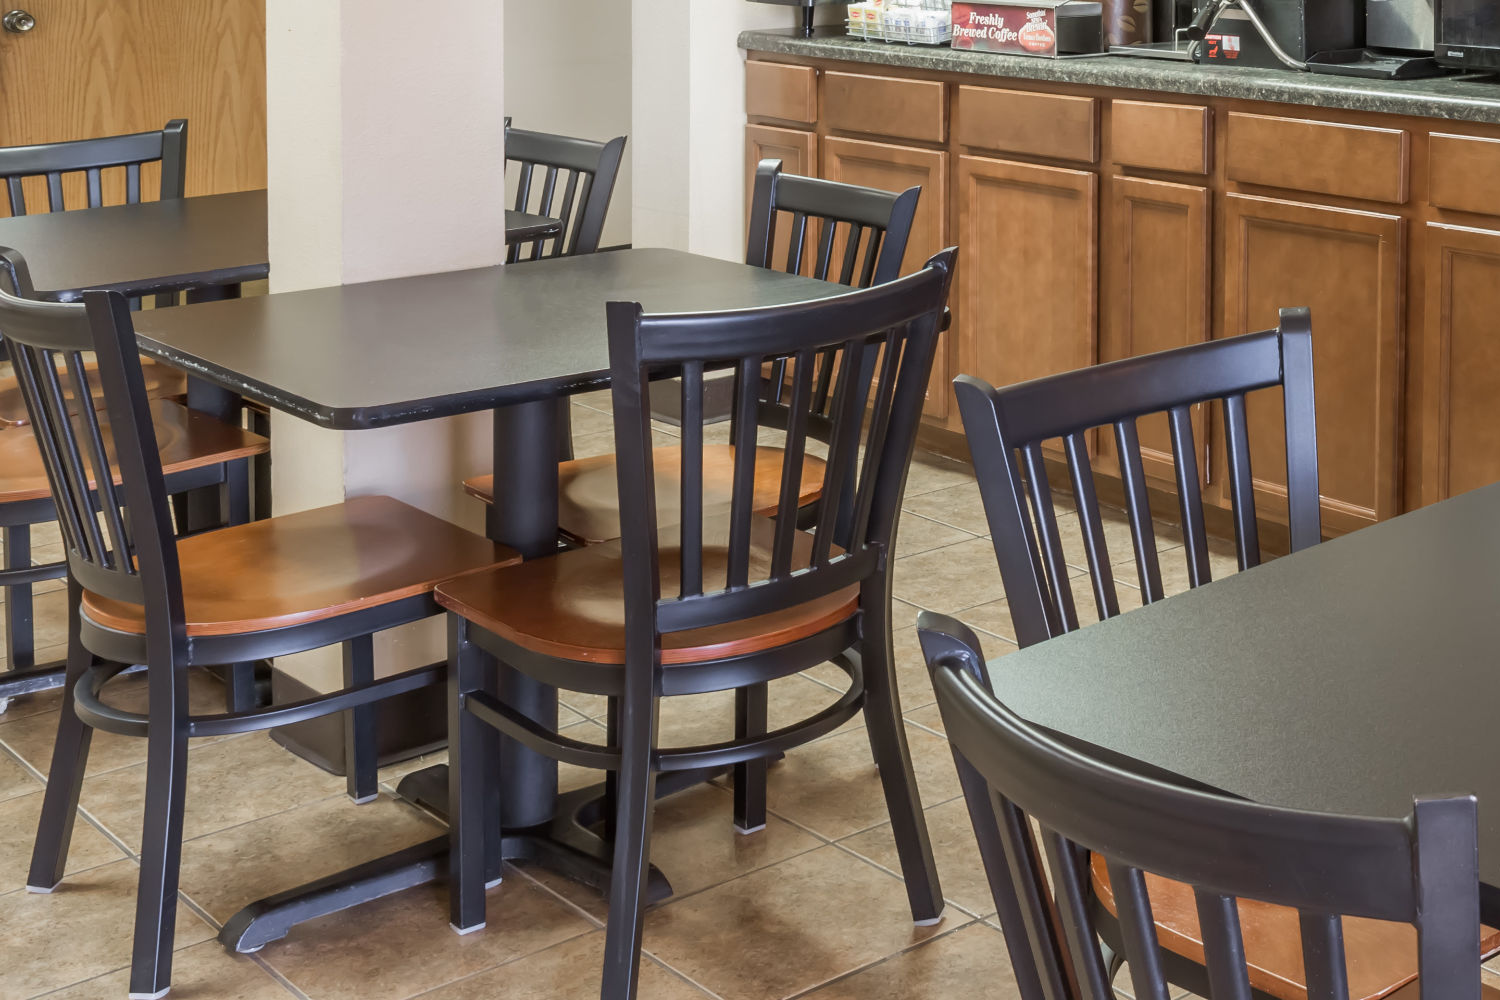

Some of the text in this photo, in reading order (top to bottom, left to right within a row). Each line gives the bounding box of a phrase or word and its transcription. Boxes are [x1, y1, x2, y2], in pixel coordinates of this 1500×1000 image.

[969, 12, 1004, 28] Freshly
[953, 24, 1018, 43] Brewed Coffee
